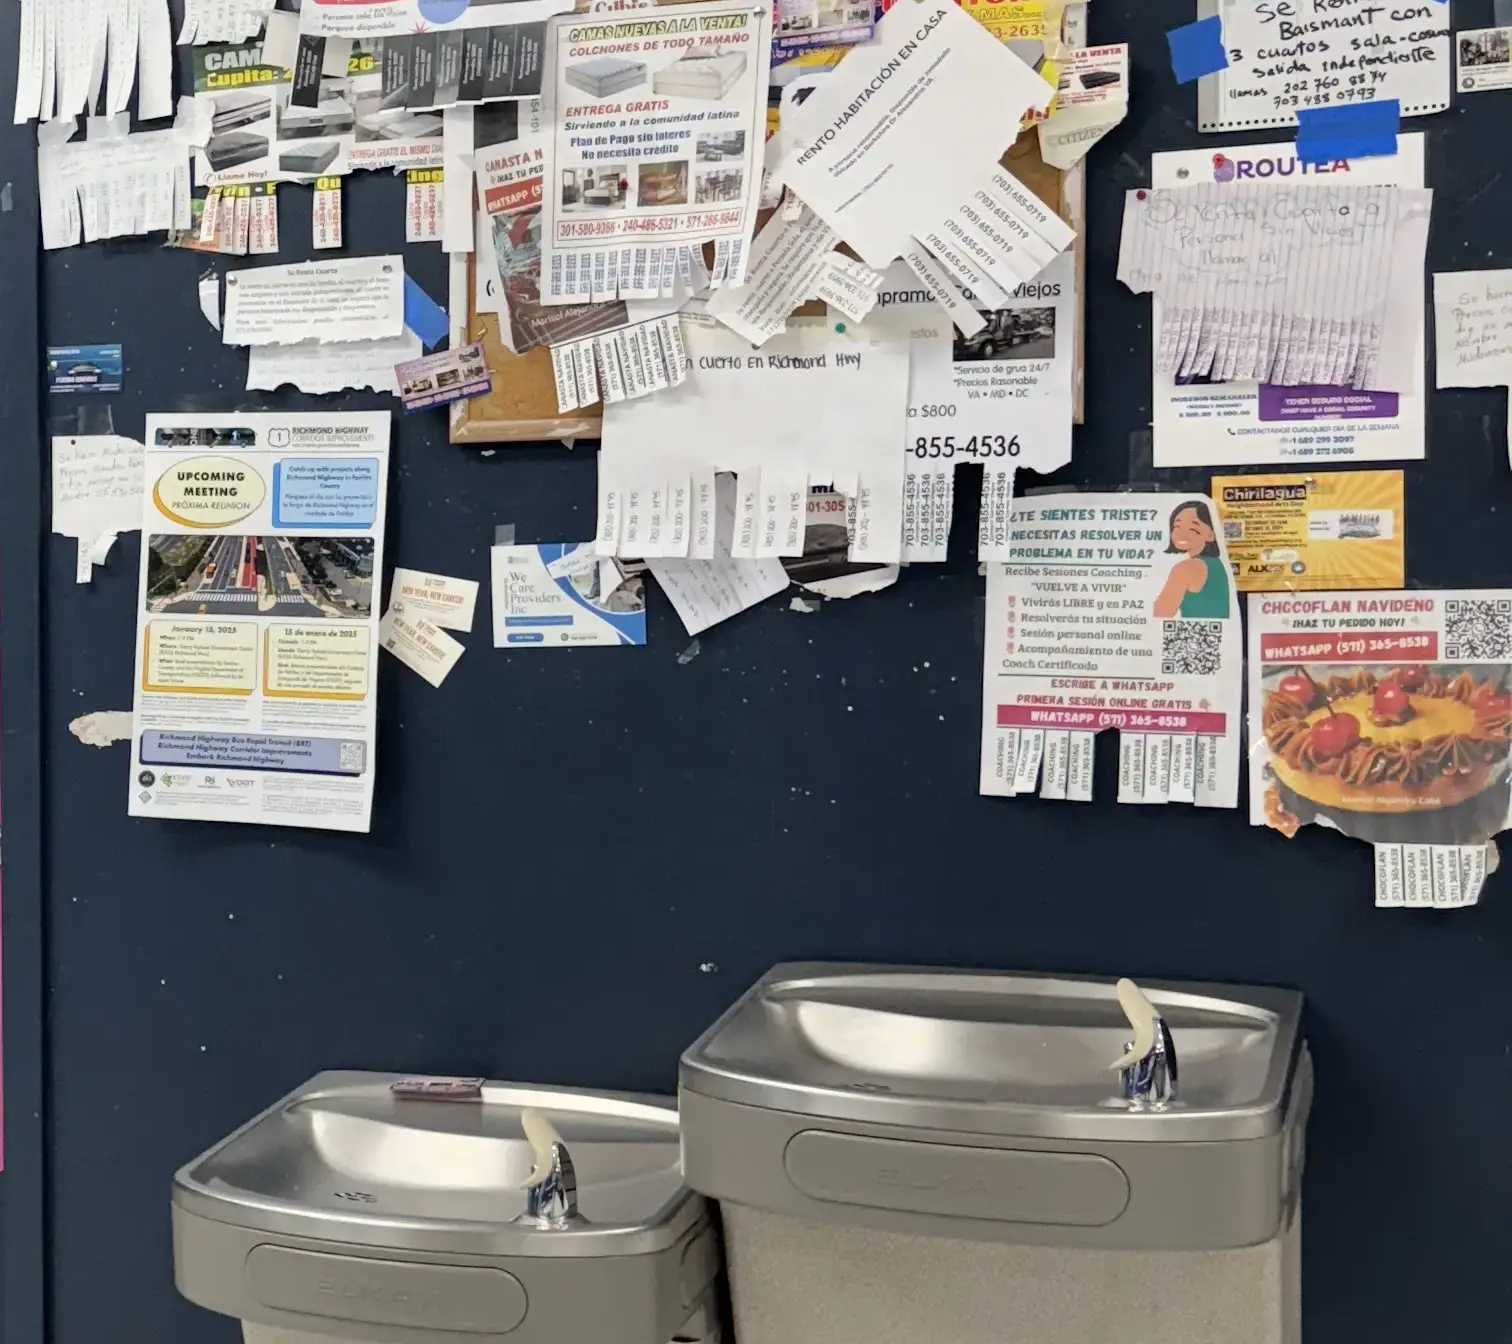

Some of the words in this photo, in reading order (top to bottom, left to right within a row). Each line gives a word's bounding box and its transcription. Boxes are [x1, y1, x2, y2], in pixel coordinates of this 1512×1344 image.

[1256, 2, 1295, 23] Se
[1391, 6, 1432, 21] con
[569, 26, 615, 42] CAMAS
[615, 21, 667, 38] NUEVAS
[680, 18, 697, 31] LA
[701, 14, 748, 30] VENTA!
[569, 42, 639, 57] COLCHONES
[643, 40, 659, 50] DE
[663, 38, 694, 49] TODO
[699, 32, 749, 45] TAMAÑO
[1230, 49, 1243, 61] 3
[1257, 40, 1330, 60] cuartos
[207, 68, 277, 87] Lupita:
[797, 128, 836, 165] RENTO
[834, 59, 901, 130] HABITACIÓN
[899, 42, 918, 60] EN
[916, 9, 948, 41] CASA
[1273, 95, 1298, 109] 703
[1338, 87, 1376, 101] 0793
[566, 105, 621, 118] ENTREGA
[626, 100, 670, 112] GRATIS
[565, 119, 616, 131] Sirviendo
[643, 113, 704, 126] comunidad
[707, 110, 740, 120] latina
[570, 136, 592, 147] Plan
[595, 135, 607, 145] de
[610, 134, 634, 146] Pago
[582, 150, 594, 159] No
[597, 147, 641, 159] necesita
[486, 153, 531, 172] CANASTA
[992, 174, 1014, 195] (703)
[1012, 191, 1047, 223] 655-0719
[975, 190, 995, 210] (703)
[994, 207, 1030, 239] 655-0719
[623, 216, 678, 232] 240-486-5321
[992, 365, 1003, 373] de
[1006, 366, 1026, 375] grua
[968, 391, 980, 399] VA
[990, 390, 1006, 398] MD
[1016, 389, 1029, 398] DC
[922, 405, 956, 418] $800
[177, 472, 245, 481] UPCOMING
[184, 487, 238, 497] MEETING
[1224, 486, 1306, 500] Chirilagua
[172, 500, 209, 510] PRÓXIMA
[906, 473, 916, 547] 703-855-4536
[921, 473, 930, 547] 703-855-4536
[1010, 510, 1035, 523] ¿TE
[1040, 509, 1095, 521] SIENTES
[1102, 509, 1158, 521] TRISTE?
[1011, 530, 1076, 540] NECESITAS
[1080, 530, 1141, 541] RESOLVER
[1146, 530, 1162, 541] UN
[1010, 548, 1072, 558] PROBLEMA
[1077, 548, 1093, 558] EN
[1097, 548, 1113, 558] TU
[1118, 549, 1154, 560] VIDA?
[510, 572, 527, 582] We
[1005, 567, 1040, 576] Recibe
[1043, 567, 1088, 577] Sesiones
[1091, 568, 1142, 579] Coaching
[510, 583, 534, 593] Care
[510, 593, 561, 603] Providers
[1021, 597, 1060, 607] Vivirás
[1063, 598, 1095, 608] LIBRE
[1122, 599, 1144, 609] PAZ
[511, 606, 527, 614] Inc
[1262, 600, 1351, 614] CHOCOFLAN
[1021, 613, 1079, 624] Resolverás
[1096, 614, 1146, 625] situación
[1323, 619, 1336, 627] TU
[1339, 618, 1376, 628] PEDIDO
[1380, 618, 1405, 627] HOY!
[171, 625, 203, 634] January
[1020, 629, 1055, 638] Sesión
[1057, 629, 1104, 640] personal
[1107, 630, 1142, 640] online
[1018, 644, 1113, 656] Acompañamiento
[1116, 645, 1128, 656] de
[1265, 644, 1331, 659] WHATSAPP
[1003, 659, 1035, 669] Coach
[1038, 660, 1098, 671] Certificado
[1051, 679, 1096, 689] ESCRIBE
[1112, 681, 1174, 691] WHATSAPP
[1017, 694, 1064, 705] PRIMERA
[1069, 694, 1105, 706] SESIÓN
[1110, 697, 1148, 708] ONLINE
[1151, 698, 1192, 711] GRATIS
[1031, 711, 1095, 723] WHATSAPP
[1098, 712, 1126, 726] (571)
